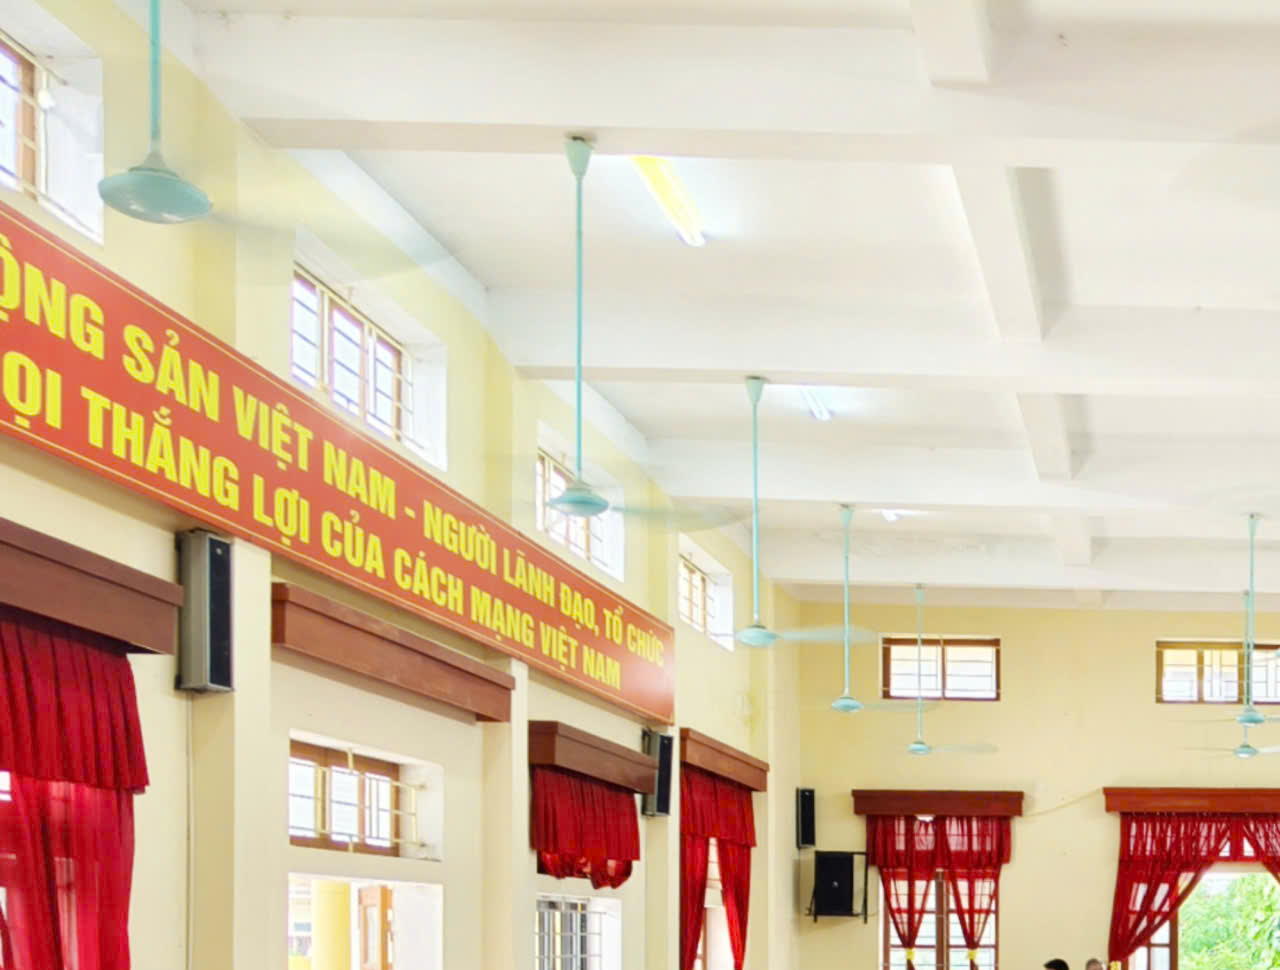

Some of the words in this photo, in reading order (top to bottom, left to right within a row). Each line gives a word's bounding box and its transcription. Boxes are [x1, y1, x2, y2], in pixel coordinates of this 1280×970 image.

[80, 385, 240, 512] THẮNG
[253, 473, 310, 549] LỢI
[321, 509, 386, 580] CỦA
[394, 548, 464, 616] CÁCH
[470, 585, 535, 649] MẠNG
[539, 621, 579, 672] VIỆT
[582, 644, 621, 690] NAM
[122, 325, 220, 423] SẢN
[233, 385, 313, 472] VIỆT
[323, 439, 396, 519] NAM
[423, 500, 497, 576] NGƯỜI
[503, 547, 555, 608] LÃNH
[602, 606, 624, 645] TỔ
